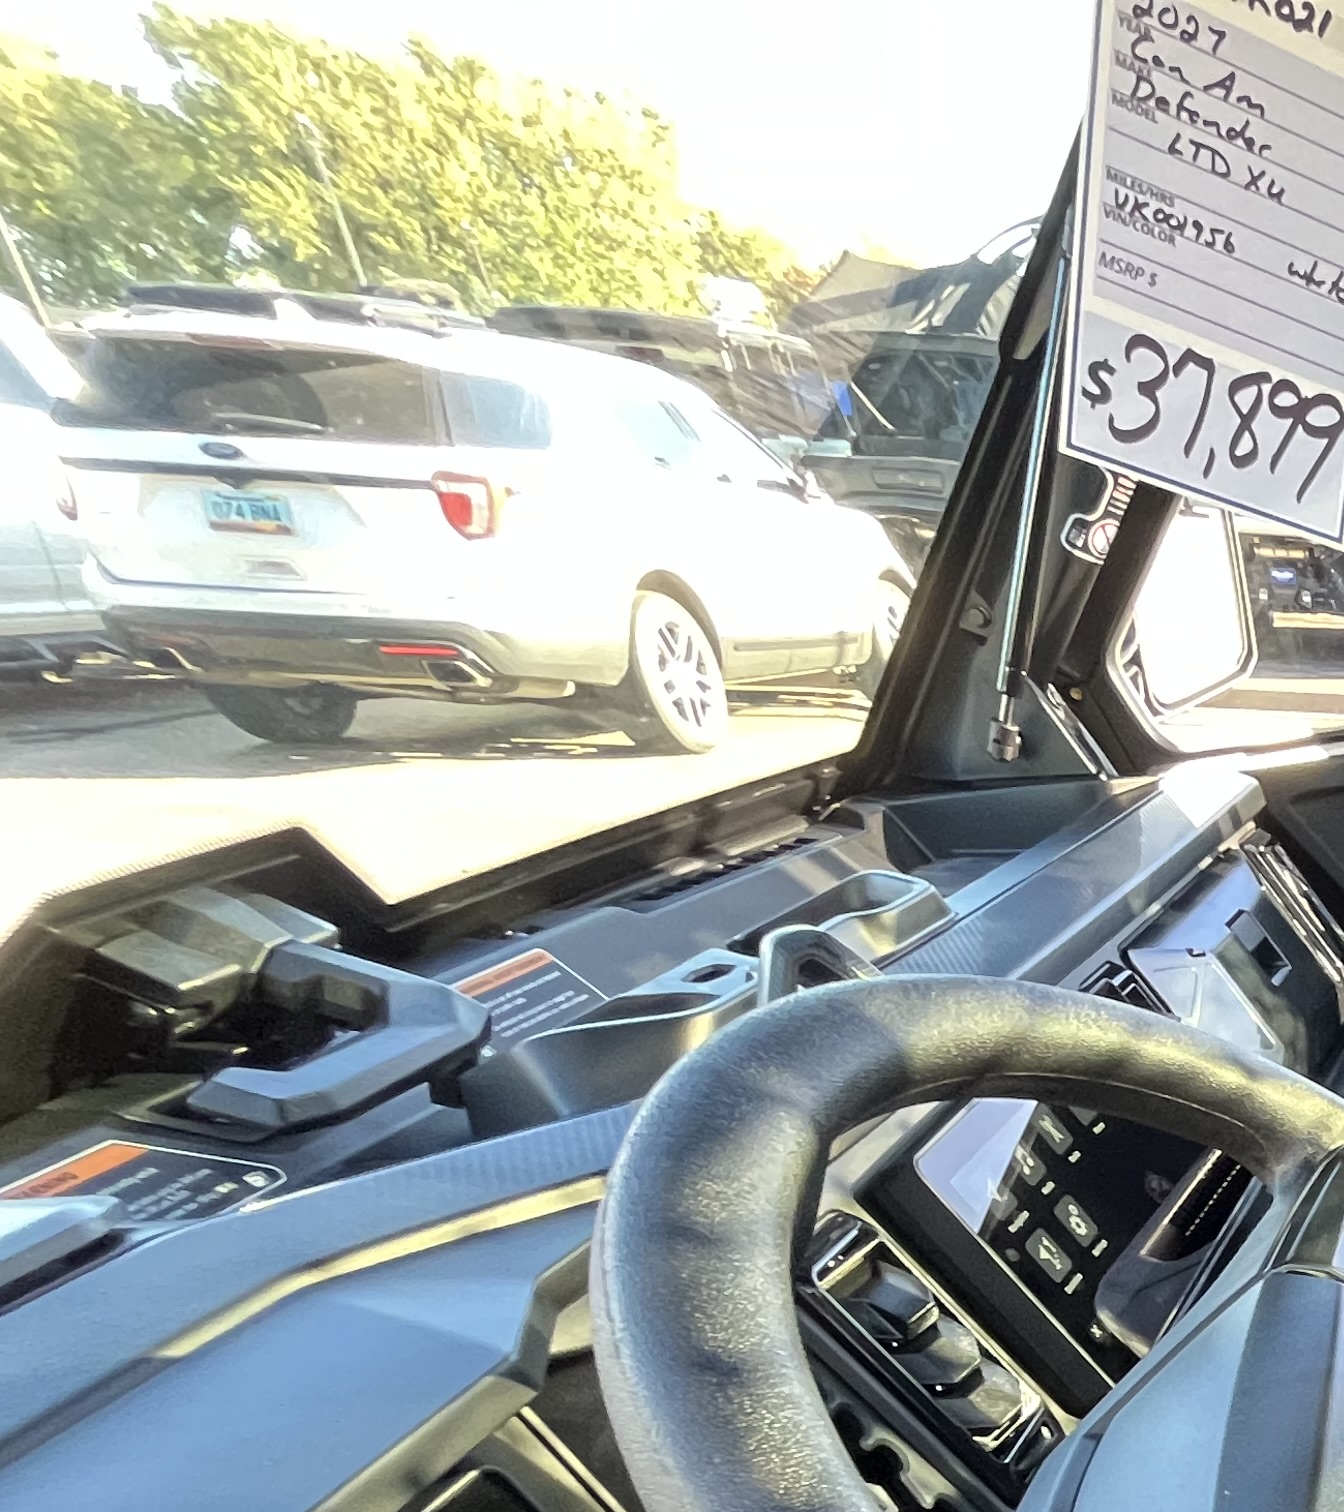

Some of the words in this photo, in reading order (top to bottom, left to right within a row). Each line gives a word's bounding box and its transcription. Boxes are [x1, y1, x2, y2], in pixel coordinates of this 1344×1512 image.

[1132, 0, 1227, 55] 2027
[1131, 74, 1272, 157] Defender
[1203, 71, 1265, 119] Am
[1168, 132, 1231, 179] LTD
[1103, 202, 1177, 248] VIN/COLOR
[1098, 251, 1145, 281] MSRP
